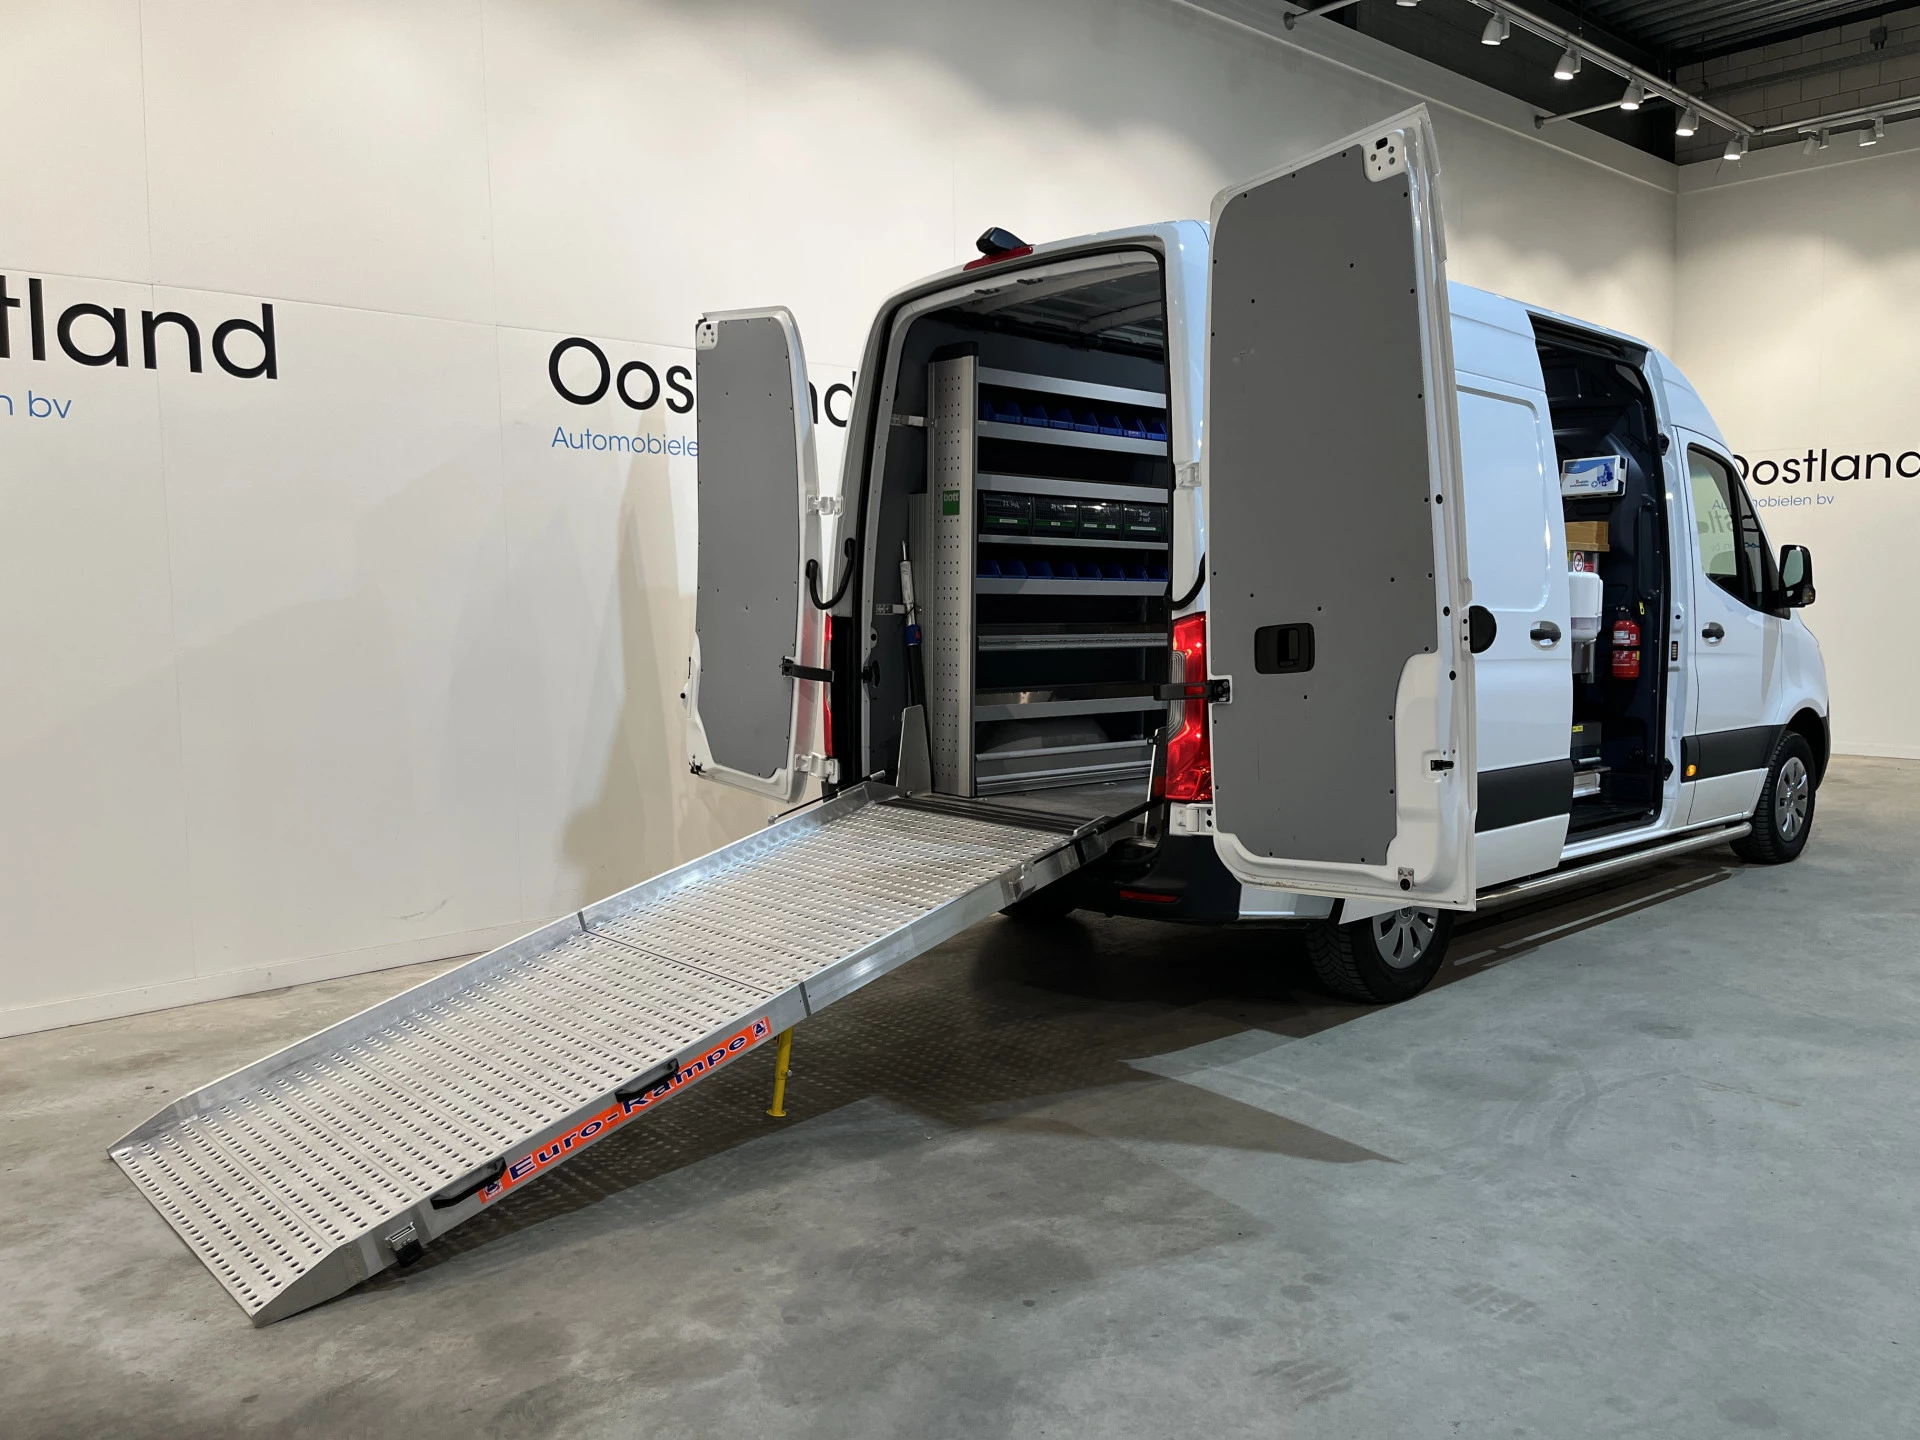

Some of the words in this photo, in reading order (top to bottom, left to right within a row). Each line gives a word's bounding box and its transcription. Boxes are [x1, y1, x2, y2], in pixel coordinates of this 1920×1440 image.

[28, 390, 72, 419] bv
[943, 491, 959, 502] bott
[1816, 493, 1835, 505] bv
